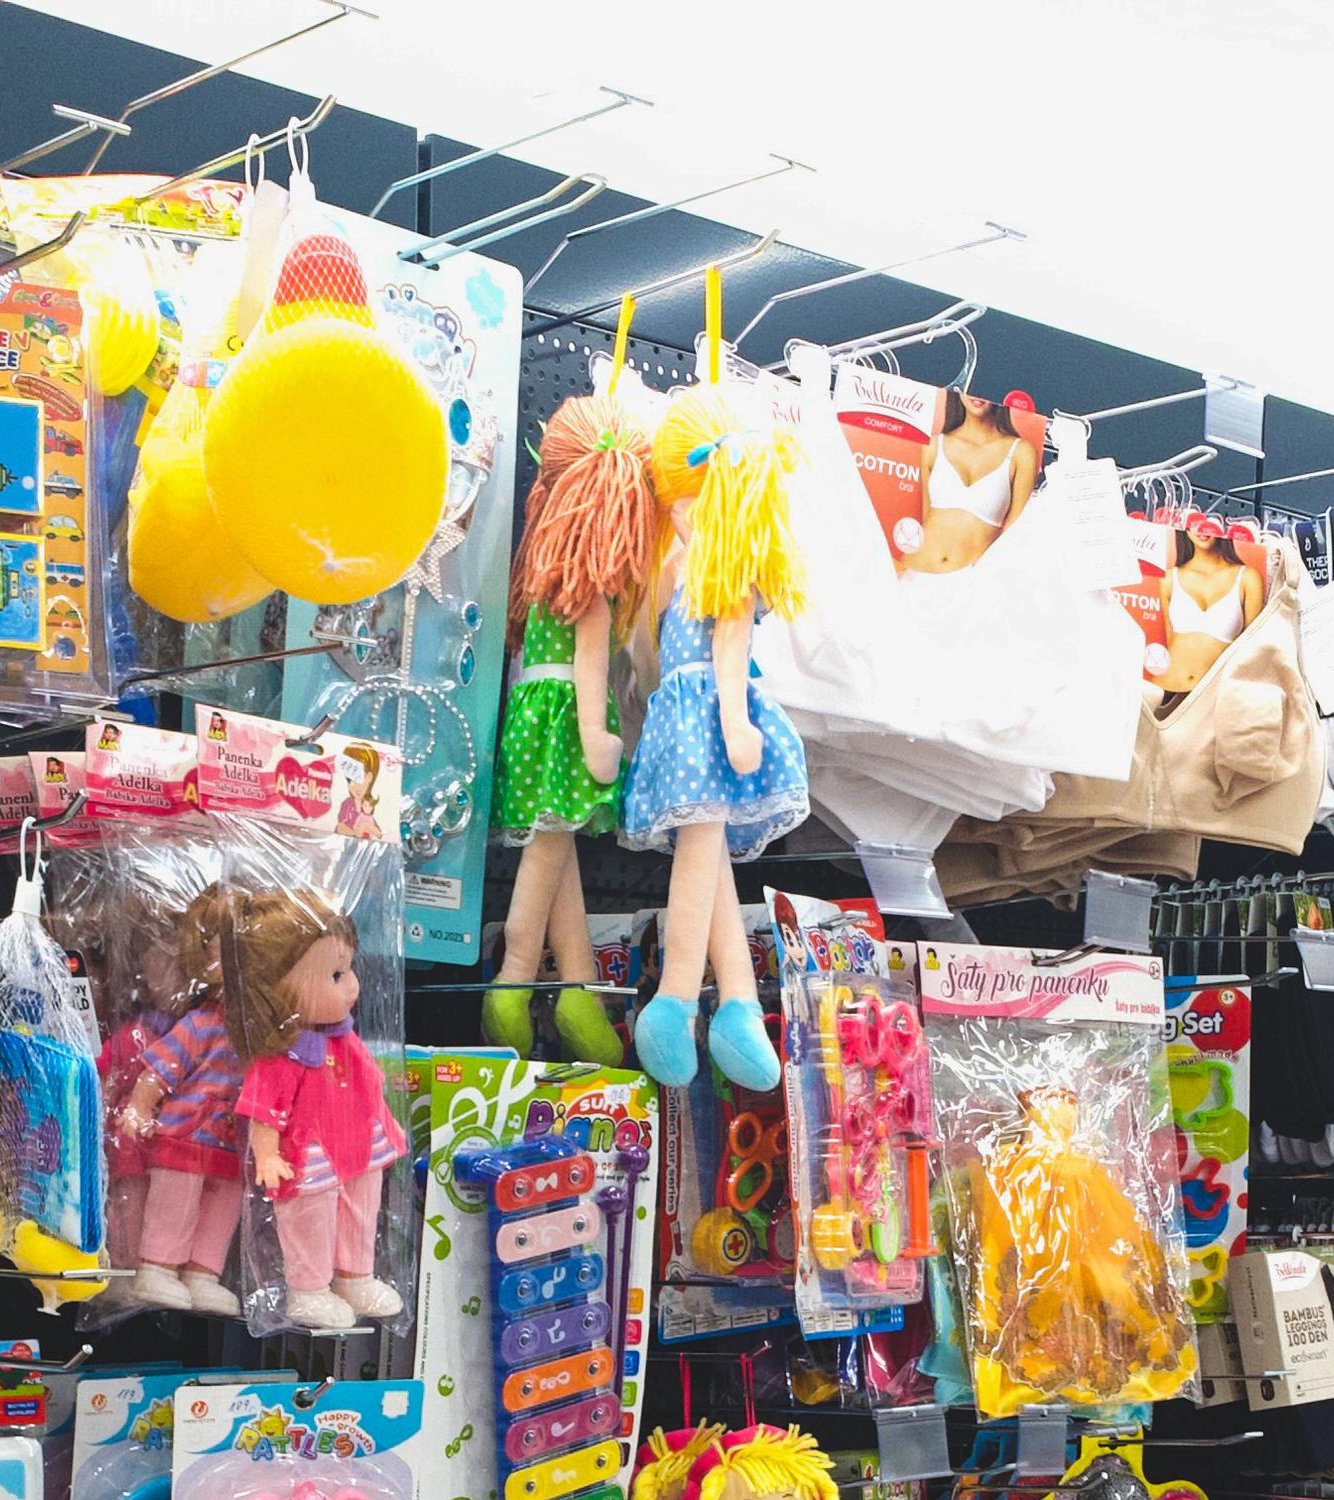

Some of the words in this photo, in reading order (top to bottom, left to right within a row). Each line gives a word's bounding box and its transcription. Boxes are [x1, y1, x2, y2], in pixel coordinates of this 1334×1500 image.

[11, 331, 30, 349] V
[853, 375, 926, 413] Bellinda
[865, 416, 903, 434] COMFORT
[853, 451, 921, 482] COTTON
[899, 481, 915, 493] bra
[217, 748, 264, 768] Panenka
[113, 773, 164, 794] Adélka
[220, 767, 260, 785] Adélka
[276, 778, 331, 804] Adélka
[941, 953, 989, 998] Šaty
[994, 969, 1027, 1000] pro
[1031, 971, 1110, 1001] panenku
[1183, 1010, 1224, 1037] Set
[1283, 1306, 1324, 1324] BAMBUS
[1284, 1320, 1327, 1335] LEGGINGS
[1286, 1332, 1307, 1348] 100
[1308, 1330, 1329, 1346] DEN
[318, 1412, 360, 1425] Happy
[235, 1427, 355, 1461] RATTLES
